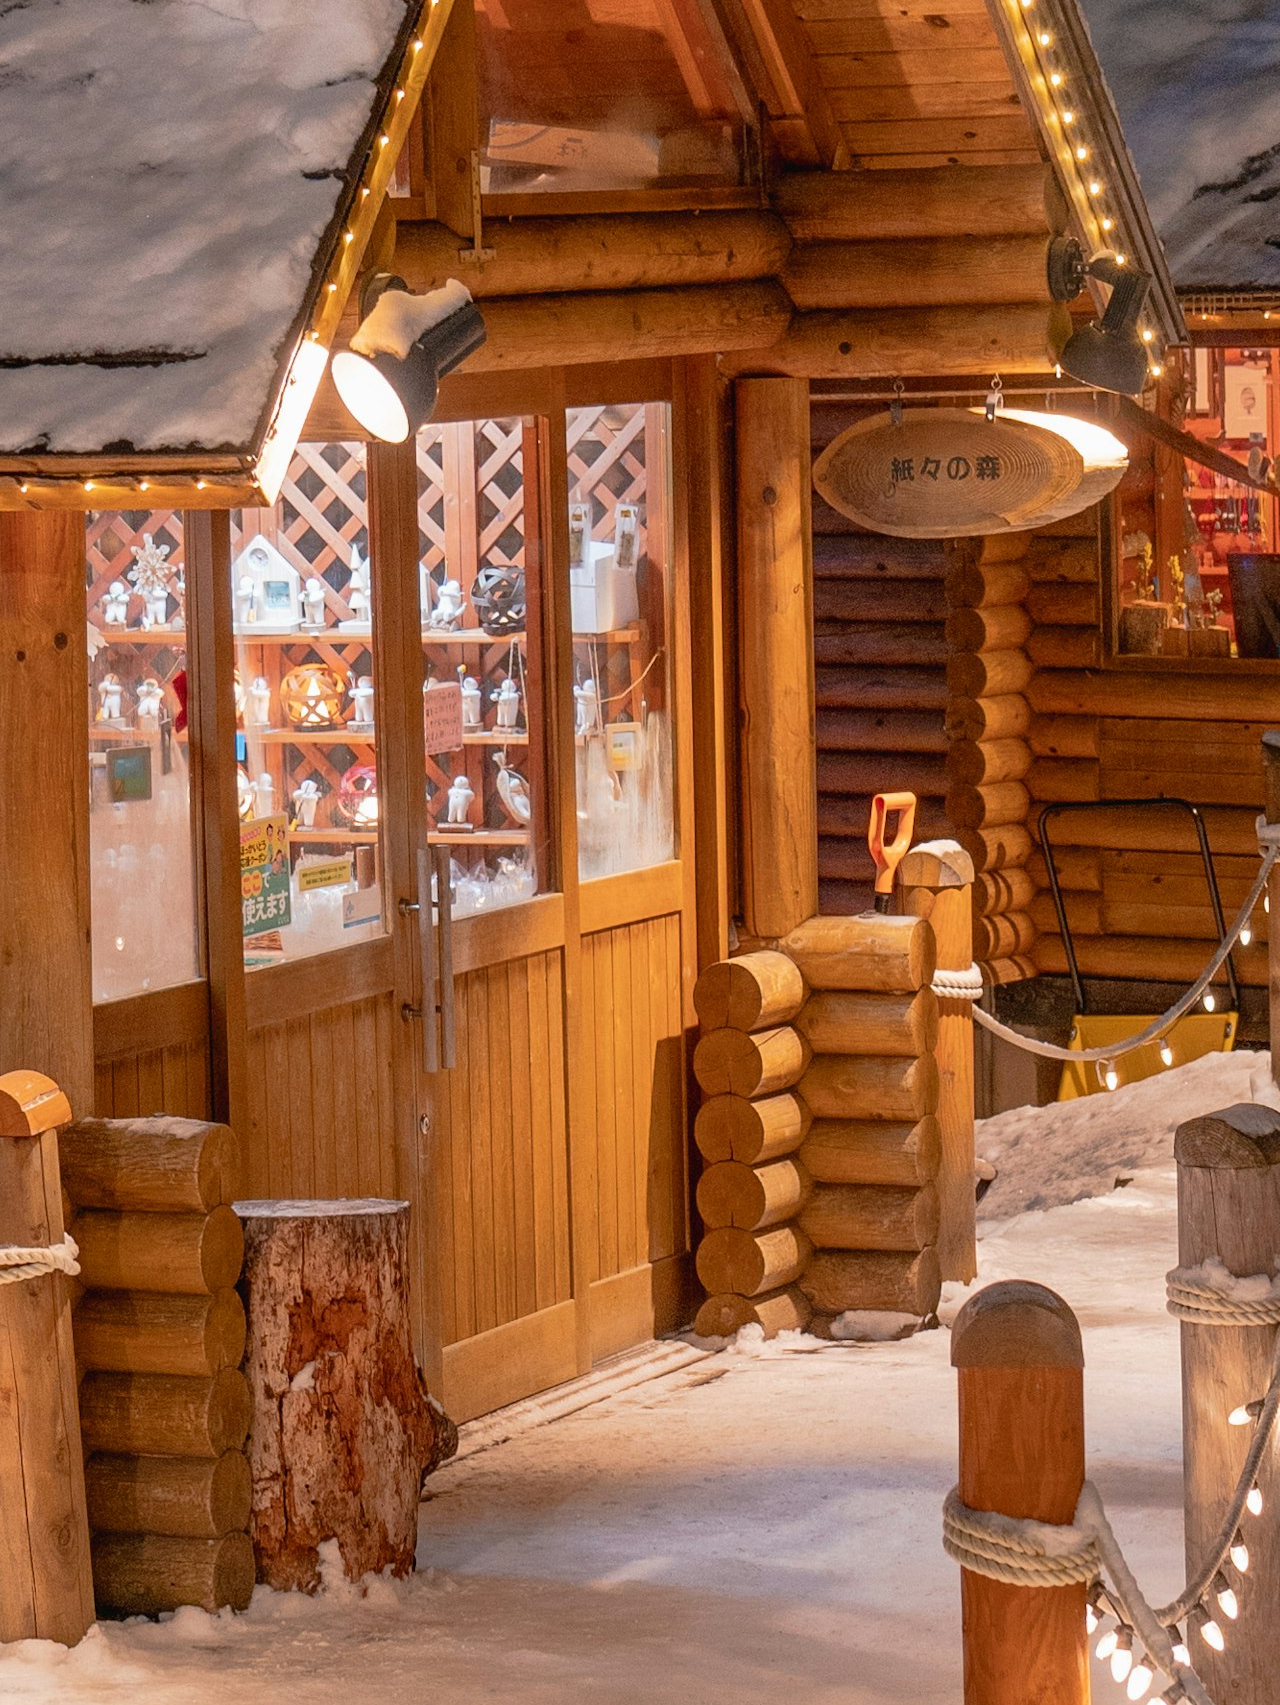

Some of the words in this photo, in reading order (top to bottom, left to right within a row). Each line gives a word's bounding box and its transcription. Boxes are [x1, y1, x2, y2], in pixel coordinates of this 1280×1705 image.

[891, 455, 1001, 482] 紙々の森
[242, 872, 270, 895] ここで
[243, 890, 289, 927] 使えます
